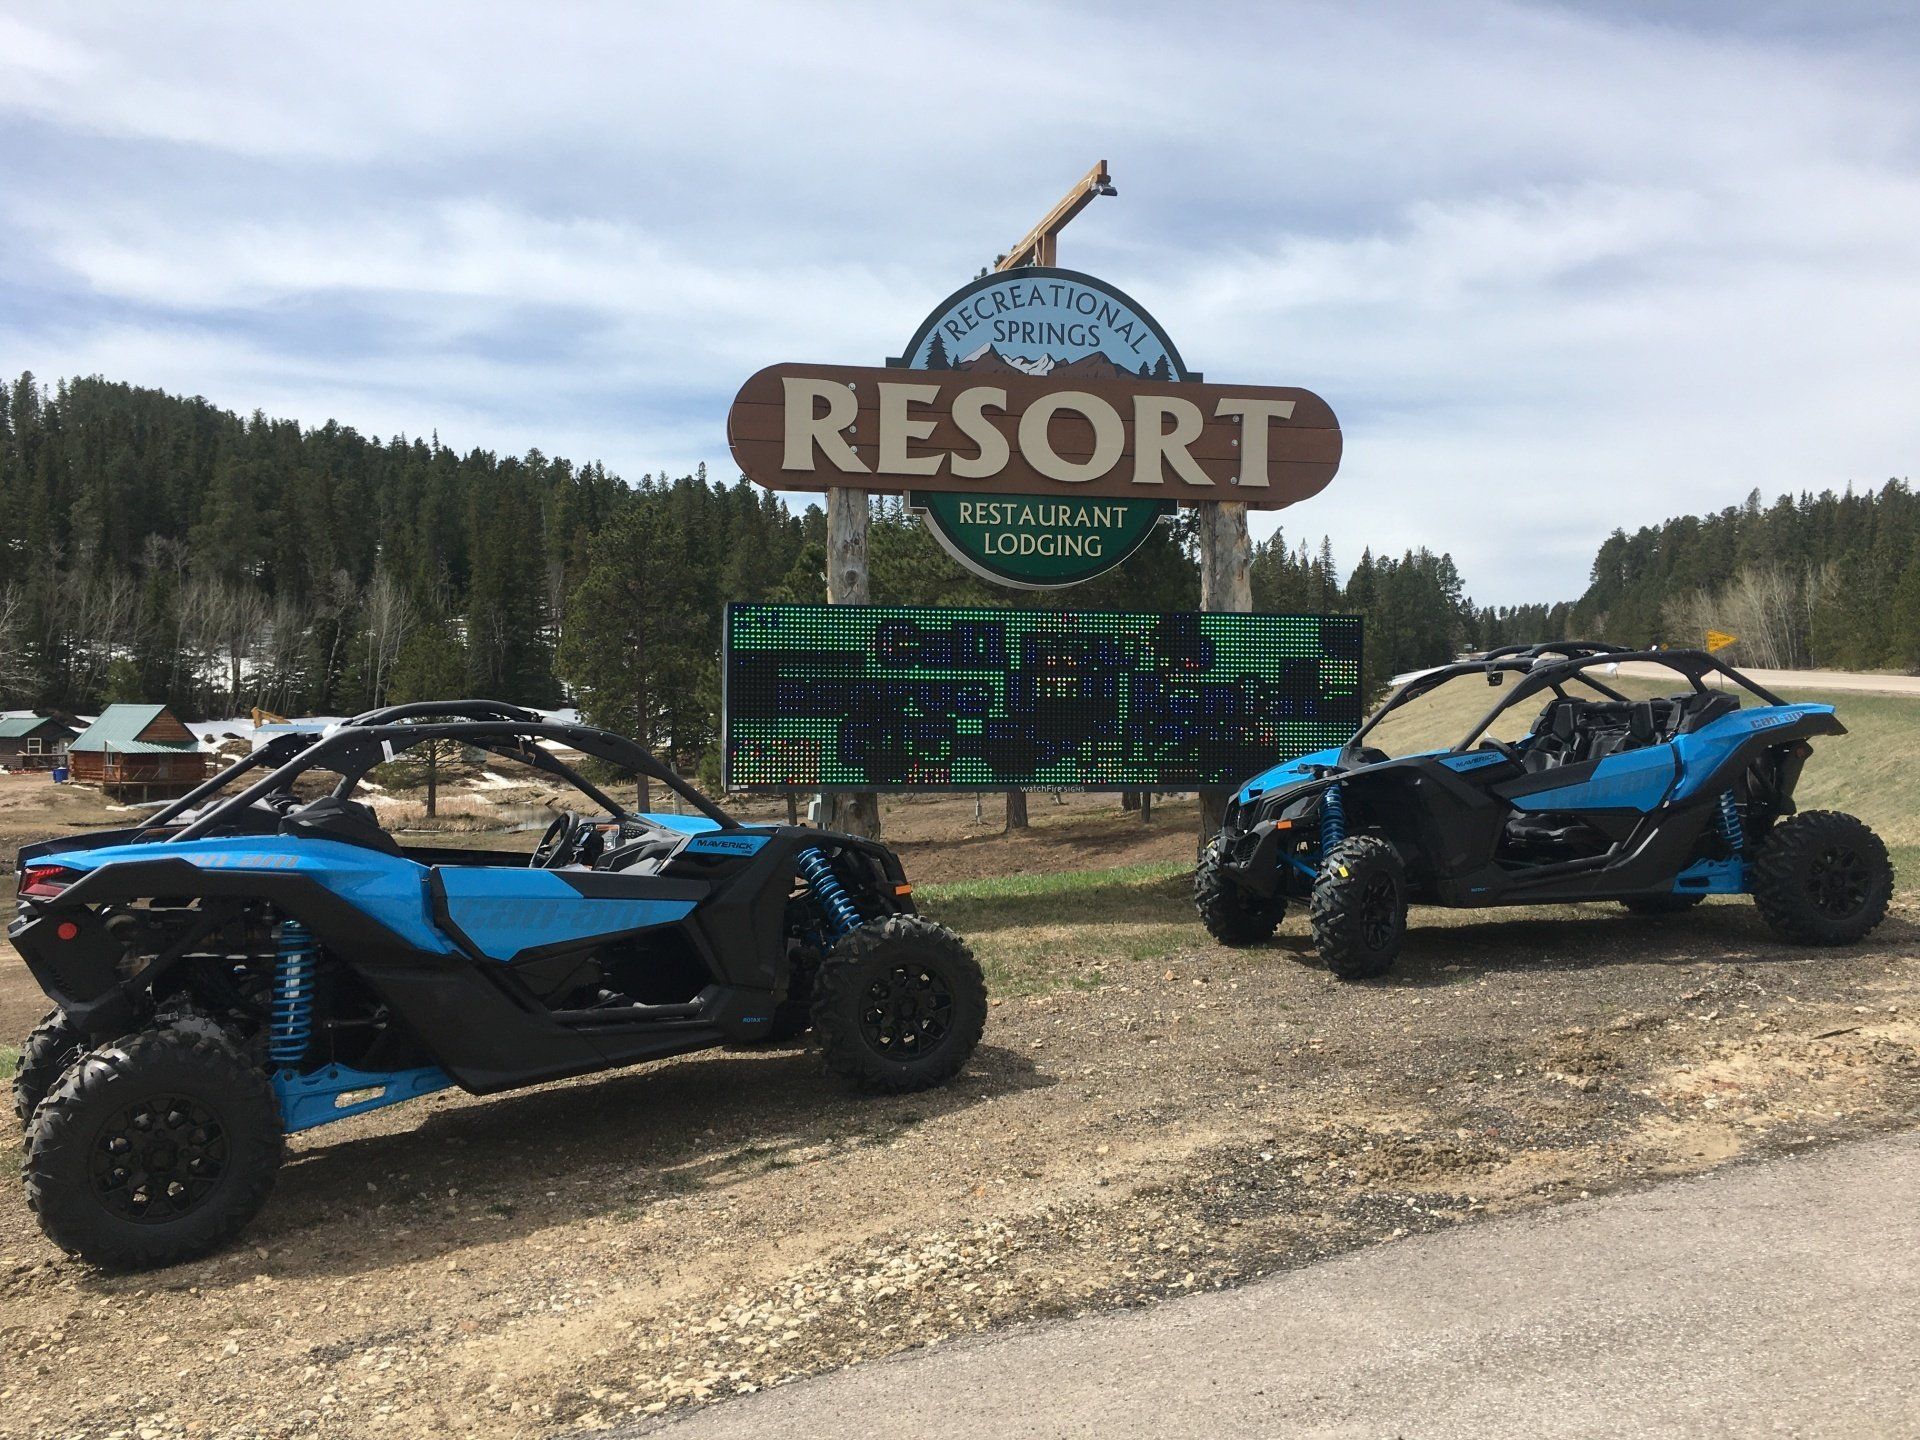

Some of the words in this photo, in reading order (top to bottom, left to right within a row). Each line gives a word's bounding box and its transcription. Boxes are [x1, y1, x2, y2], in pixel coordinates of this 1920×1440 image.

[943, 284, 1148, 355] RECREATIONAL
[993, 319, 1101, 348] SPRINGS
[780, 376, 1297, 488] RESORT
[959, 502, 1128, 529] RESTAURANT
[984, 532, 1103, 557] LODGING
[697, 839, 753, 850] MAVERICK
